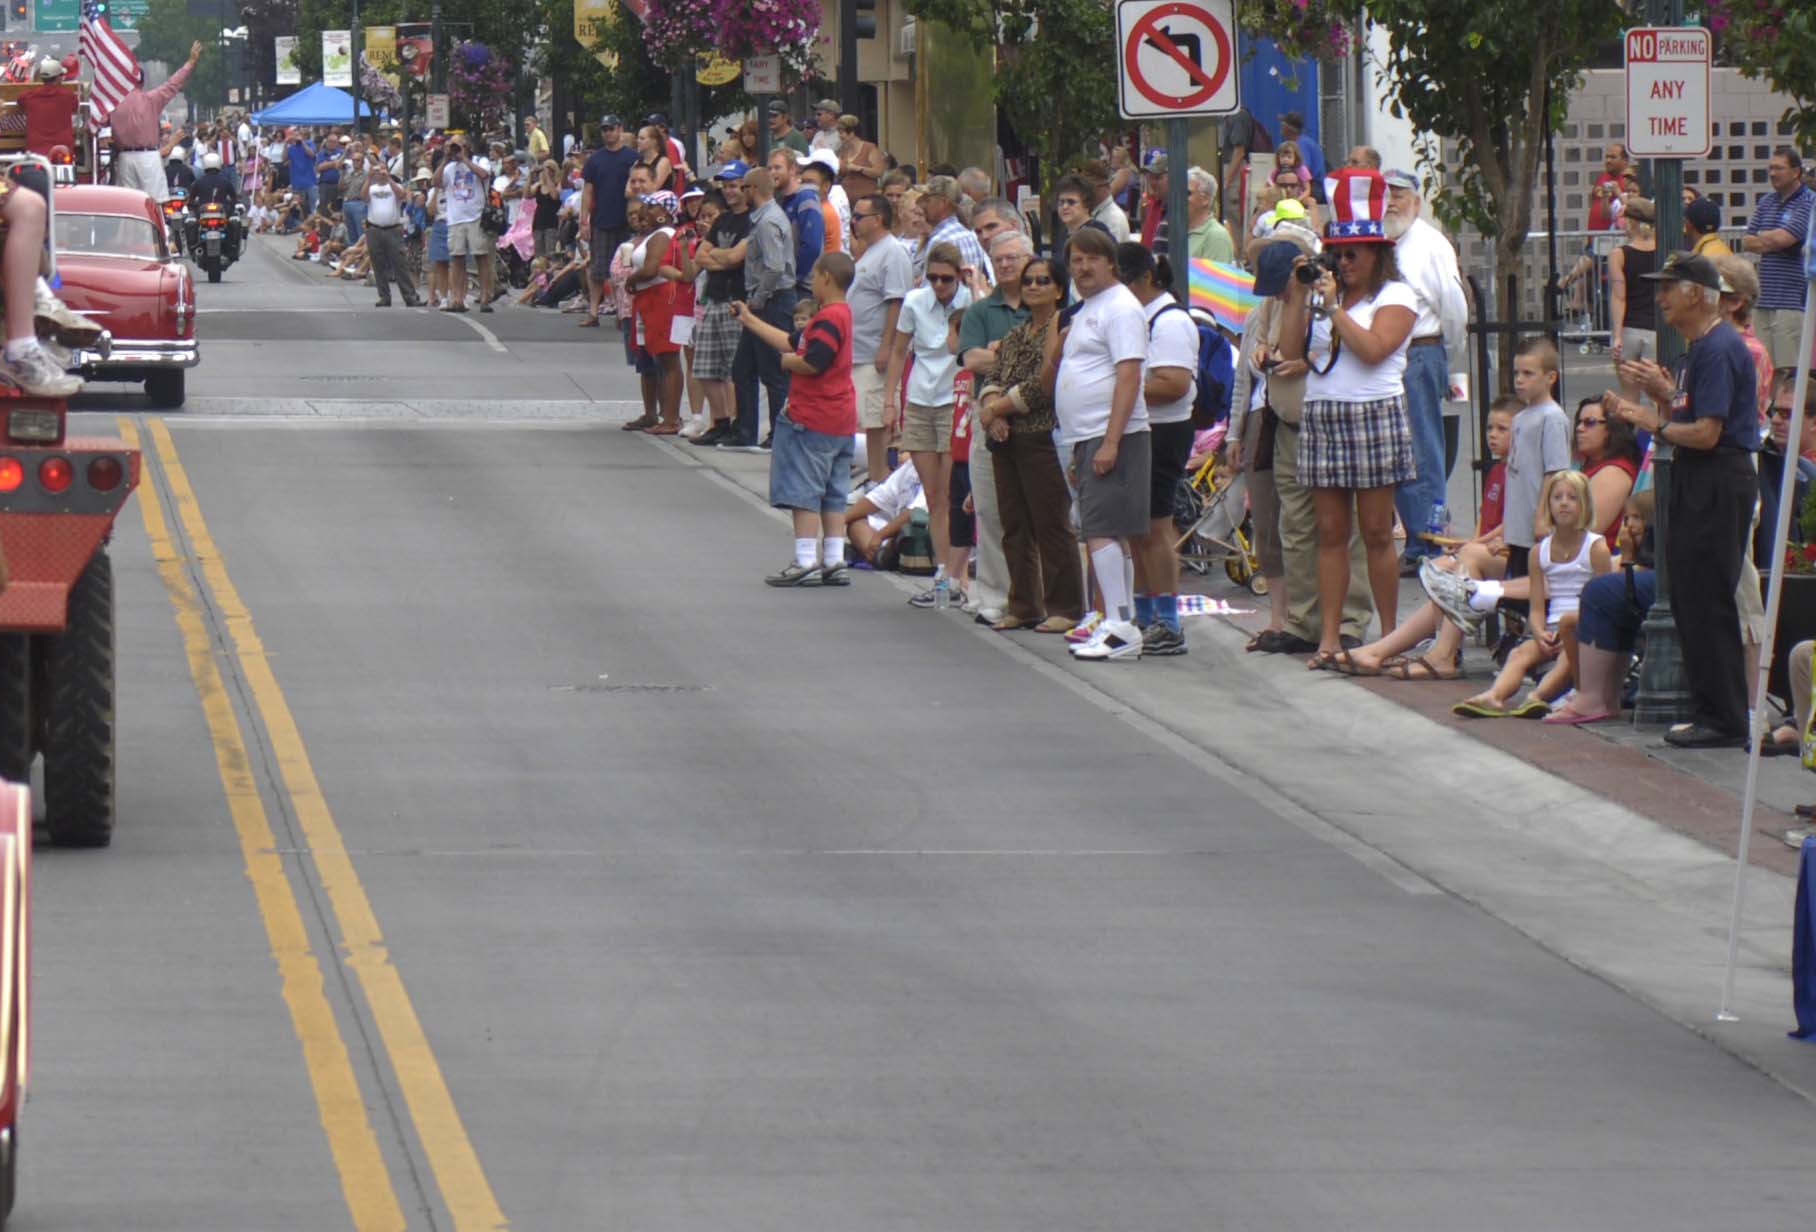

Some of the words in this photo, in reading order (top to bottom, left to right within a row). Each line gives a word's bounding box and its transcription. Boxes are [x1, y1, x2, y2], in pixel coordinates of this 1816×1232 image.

[1629, 34, 1656, 60] NO
[1658, 39, 1705, 56] PARKING
[1650, 79, 1685, 99] ANY
[1648, 116, 1688, 137] TIME
